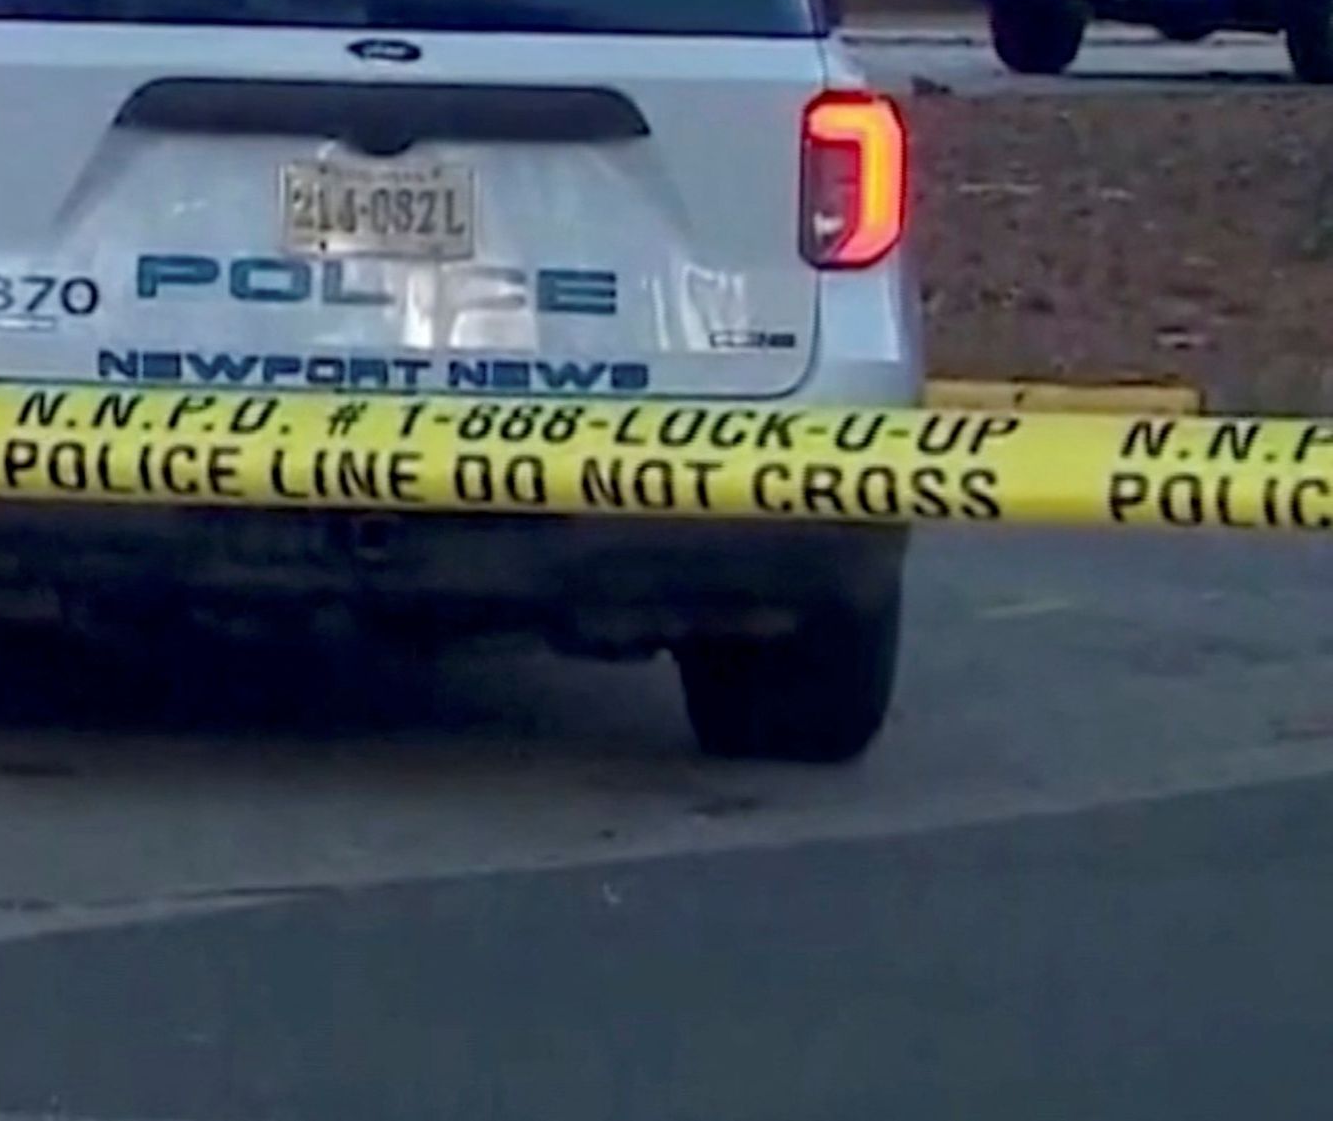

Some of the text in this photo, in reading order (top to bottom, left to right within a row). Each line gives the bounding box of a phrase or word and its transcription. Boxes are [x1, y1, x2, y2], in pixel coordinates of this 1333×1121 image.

[97, 348, 430, 390] NEWPORT
[448, 359, 649, 391] NEWS
[17, 391, 1021, 456] N.N.P.D. # 1-888-LOCK-U-UP
[4, 439, 1001, 520] POLICE LINE DO NOT CROSS
